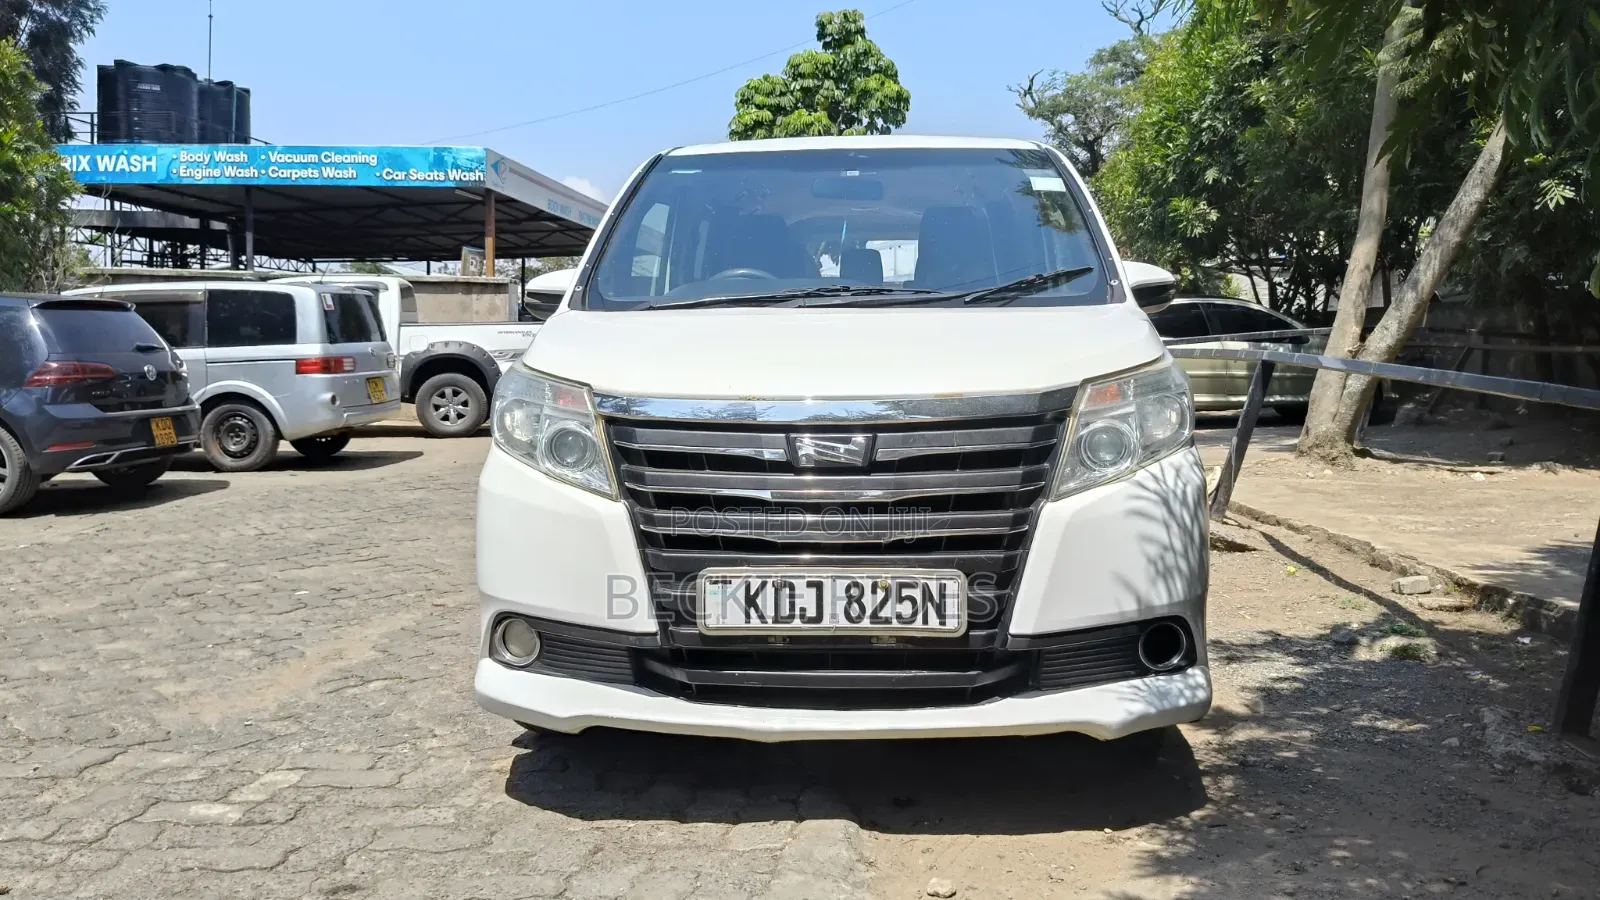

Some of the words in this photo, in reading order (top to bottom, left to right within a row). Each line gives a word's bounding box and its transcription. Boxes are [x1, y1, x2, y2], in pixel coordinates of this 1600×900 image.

[97, 154, 157, 173] WASH
[179, 151, 211, 164] Body
[213, 151, 248, 163] Wash
[268, 151, 319, 163] Vacuum
[321, 152, 378, 166] Cleaning
[179, 166, 221, 180] Engine
[223, 166, 259, 178] Wash
[268, 166, 320, 181] Carpets
[321, 167, 357, 179] Wash
[383, 170, 407, 181] Car
[409, 168, 445, 181] Seats
[744, 580, 824, 625] KDJ
[844, 580, 948, 626] 825N
